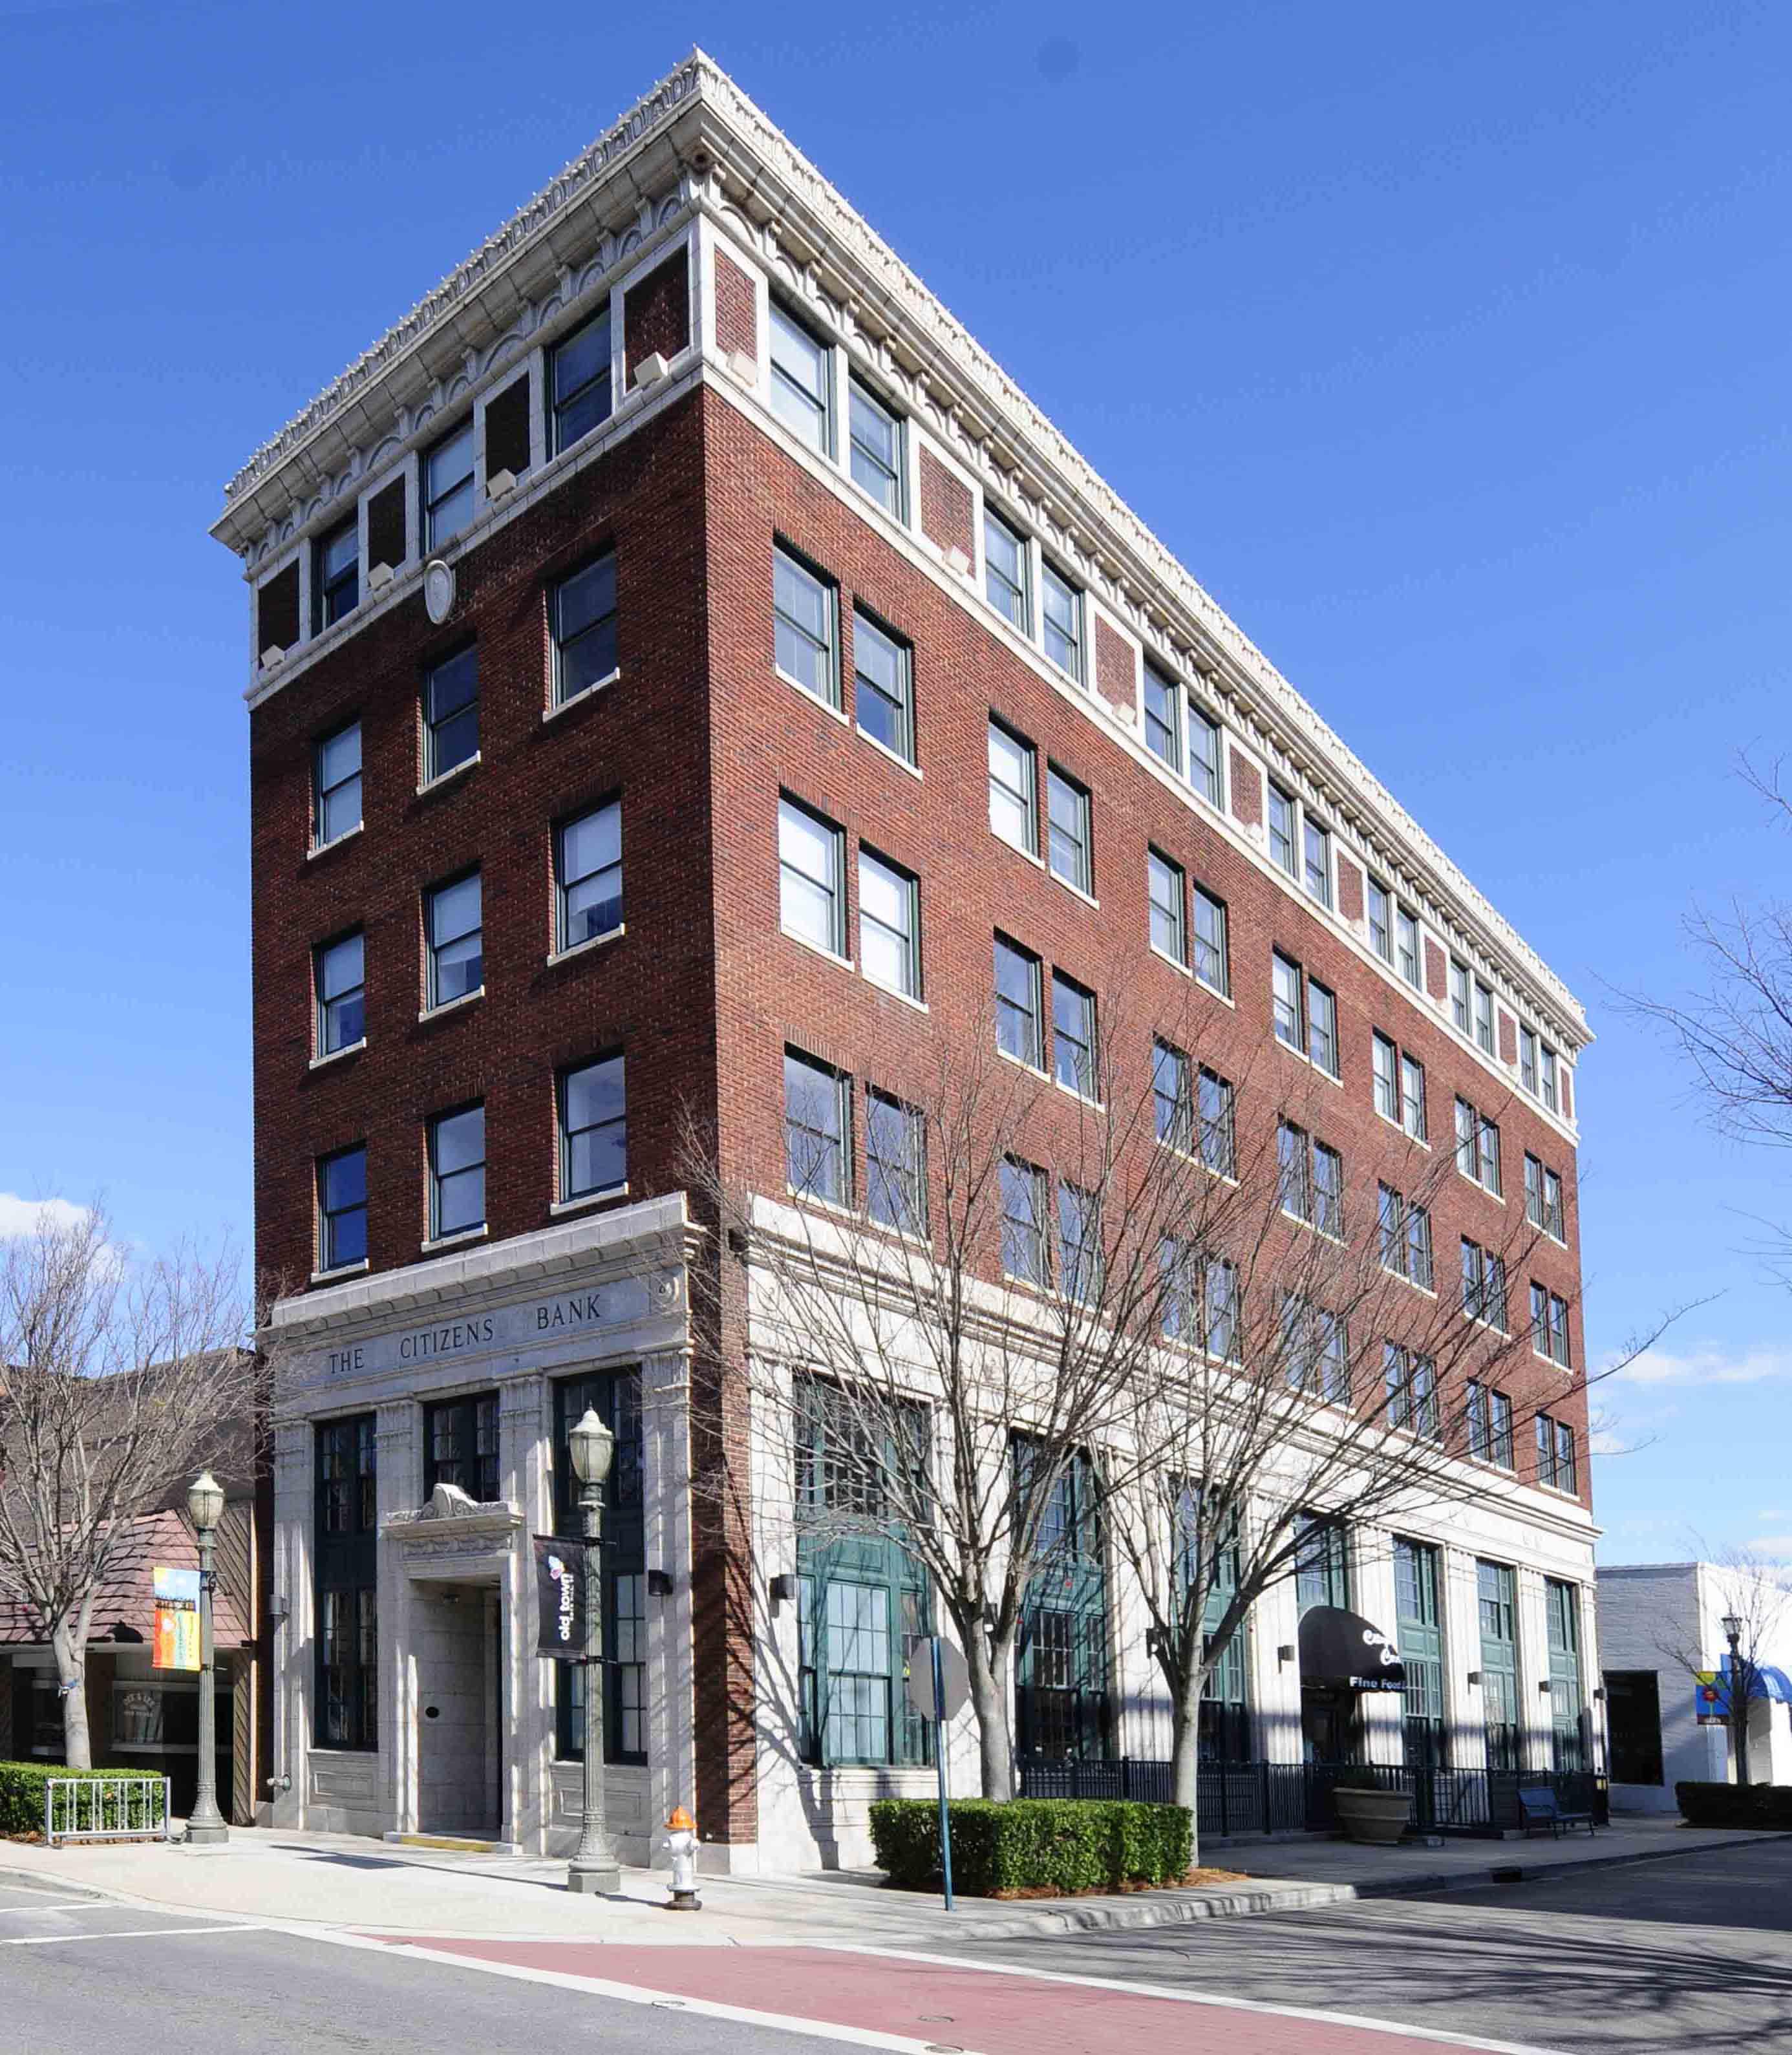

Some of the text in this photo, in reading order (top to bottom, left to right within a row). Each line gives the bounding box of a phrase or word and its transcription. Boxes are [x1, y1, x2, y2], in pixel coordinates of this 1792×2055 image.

[330, 1294, 601, 1374] THE CITIZENS BANK
[559, 1573, 570, 1641] old town
[1350, 1676, 1378, 1688] Fine
